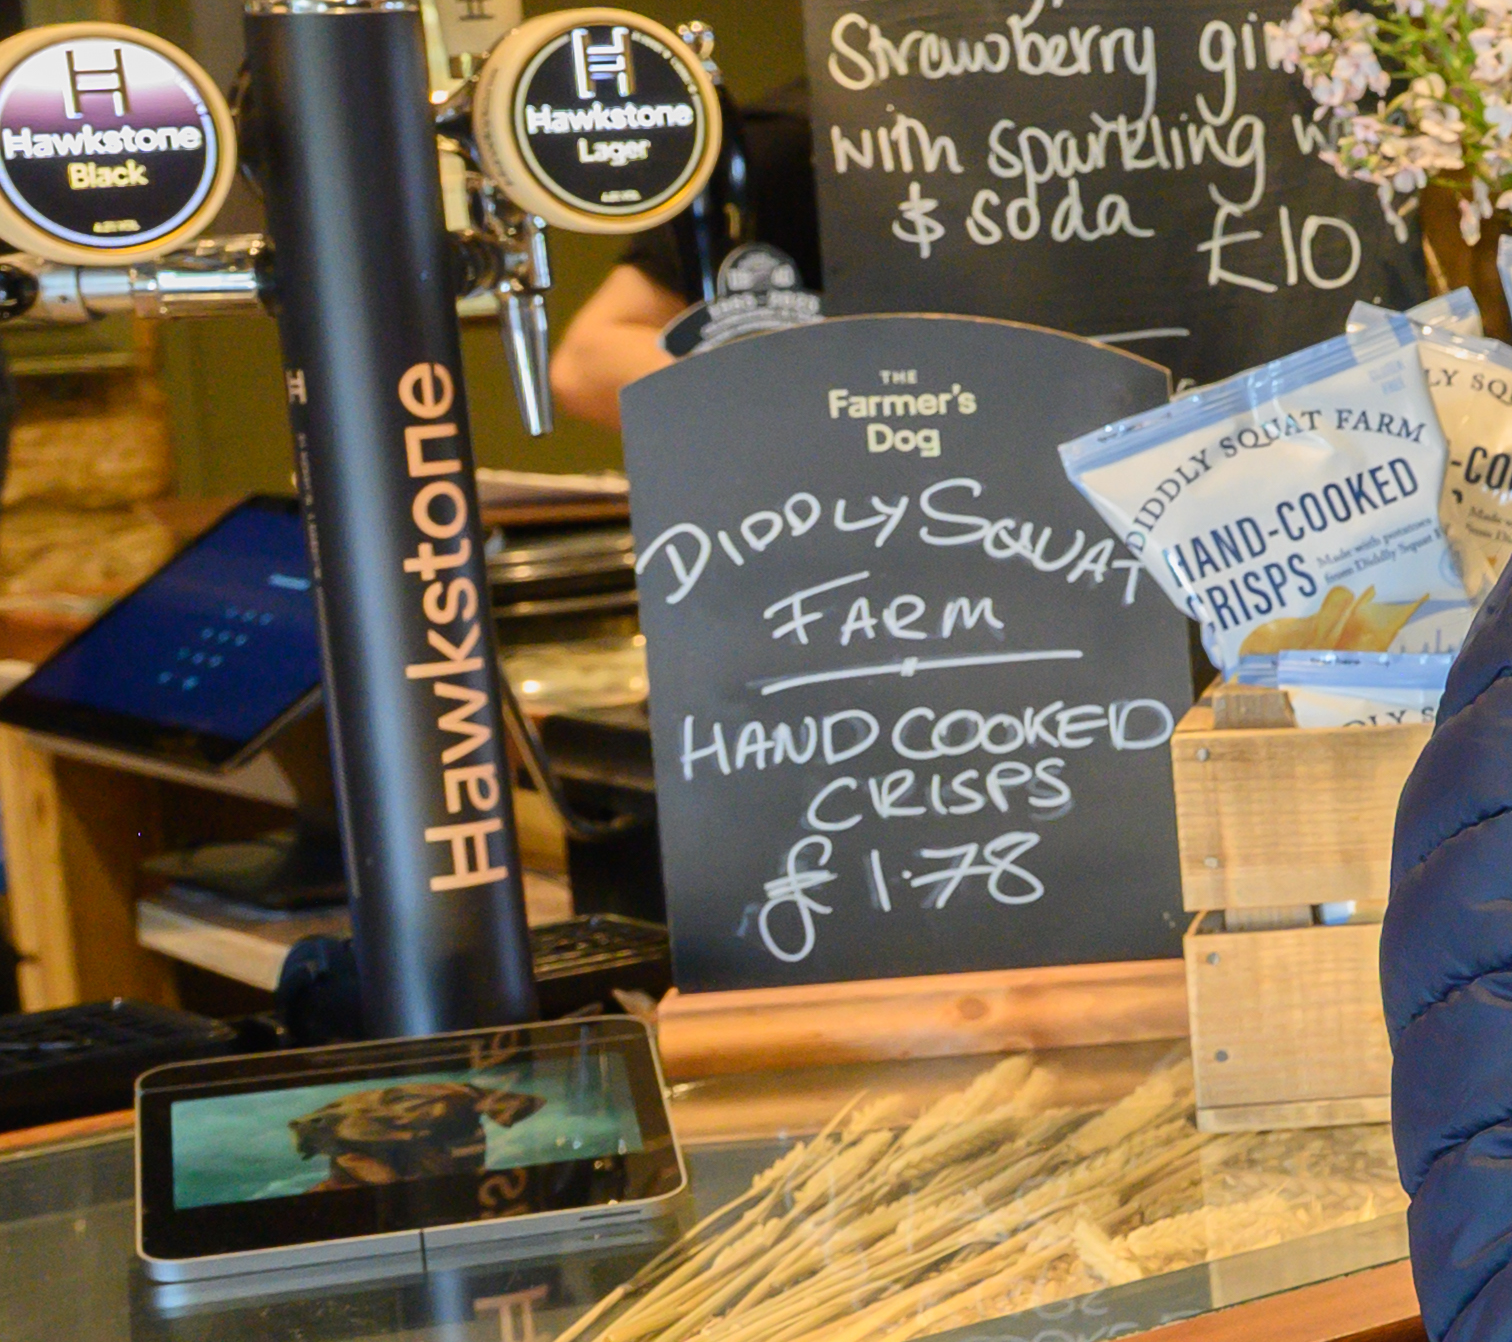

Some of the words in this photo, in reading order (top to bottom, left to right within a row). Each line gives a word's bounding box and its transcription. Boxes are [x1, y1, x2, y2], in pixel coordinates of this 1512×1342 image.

[827, 13, 1157, 121] Strawberry
[2, 124, 202, 160] Hawkstone
[525, 101, 694, 134] Hawkstone
[577, 137, 652, 167] Lager
[68, 159, 149, 190] Black
[831, 104, 963, 173] with
[988, 112, 1267, 216] sparkling
[967, 180, 1155, 244] soda
[1197, 206, 1361, 291] £10
[828, 382, 977, 420] Farmer's
[880, 369, 918, 385] THE
[867, 423, 941, 458] Dog
[1125, 450, 1216, 554] DIDDLY
[1219, 409, 1323, 459] SQUAT
[1335, 408, 1427, 445] FARM
[635, 492, 909, 604] DIDDLY
[919, 477, 1145, 605] SQUAT
[399, 361, 508, 892] Hawkstone
[763, 570, 1005, 646] FARM
[806, 758, 1072, 832] CRISPS
